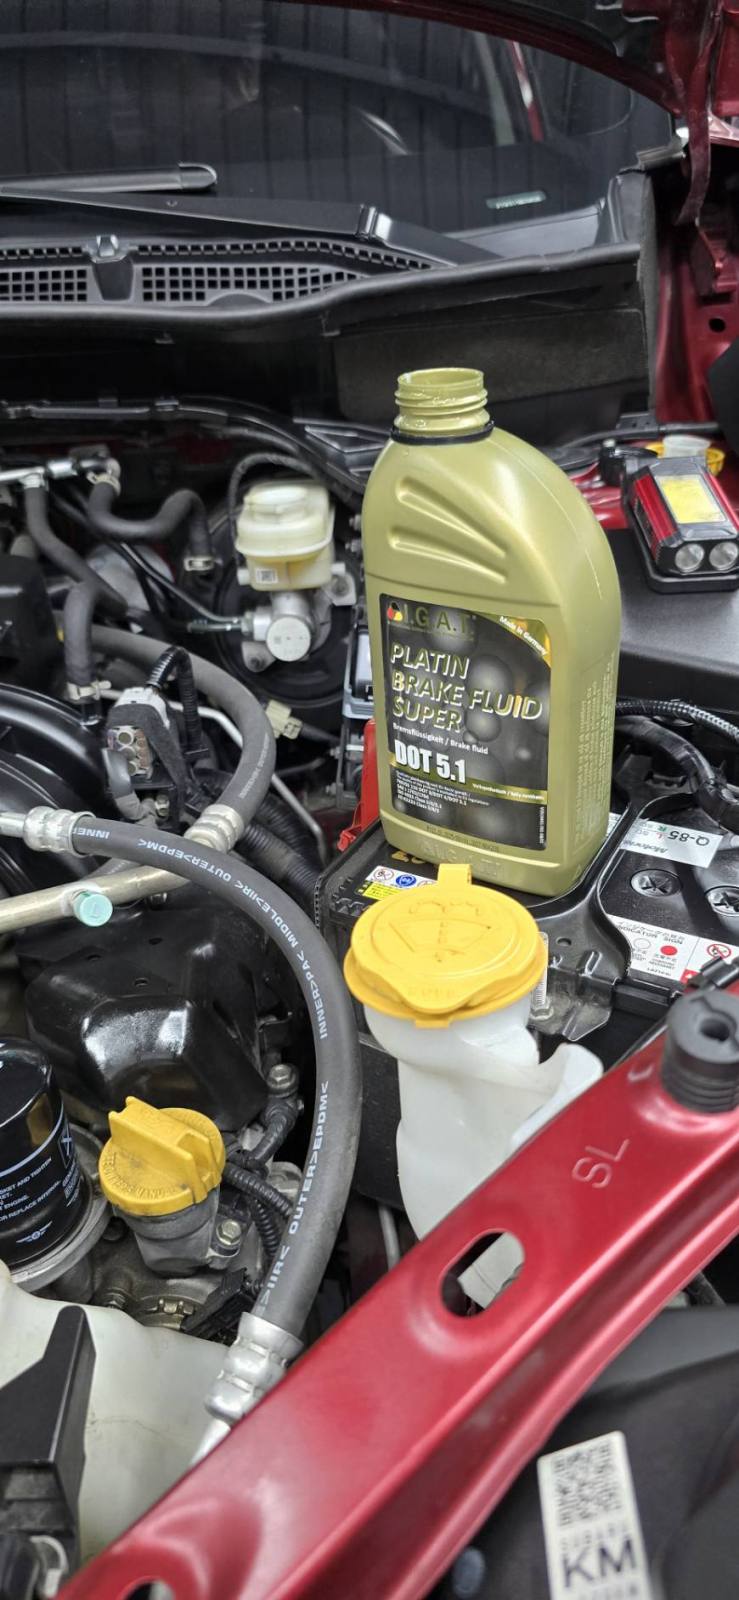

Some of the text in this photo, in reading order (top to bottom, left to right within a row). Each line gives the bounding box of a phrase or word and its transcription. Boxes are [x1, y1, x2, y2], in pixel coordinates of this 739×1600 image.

[390, 643, 470, 680] PLATIN
[523, 632, 547, 656] Germany
[391, 669, 543, 720] BRAKE FLUID
[392, 695, 463, 734] SUPER
[394, 739, 433, 774] DOT
[436, 752, 467, 784] 5.1
[450, 739, 470, 751] Brake
[472, 744, 489, 755] fluid
[667, 830, 711, 847] Q-85
[17, 1176, 31, 1188] AND
[571, 1138, 630, 1189] SL
[8, 1200, 37, 1219] REPLACE
[561, 1534, 638, 1589] KM
